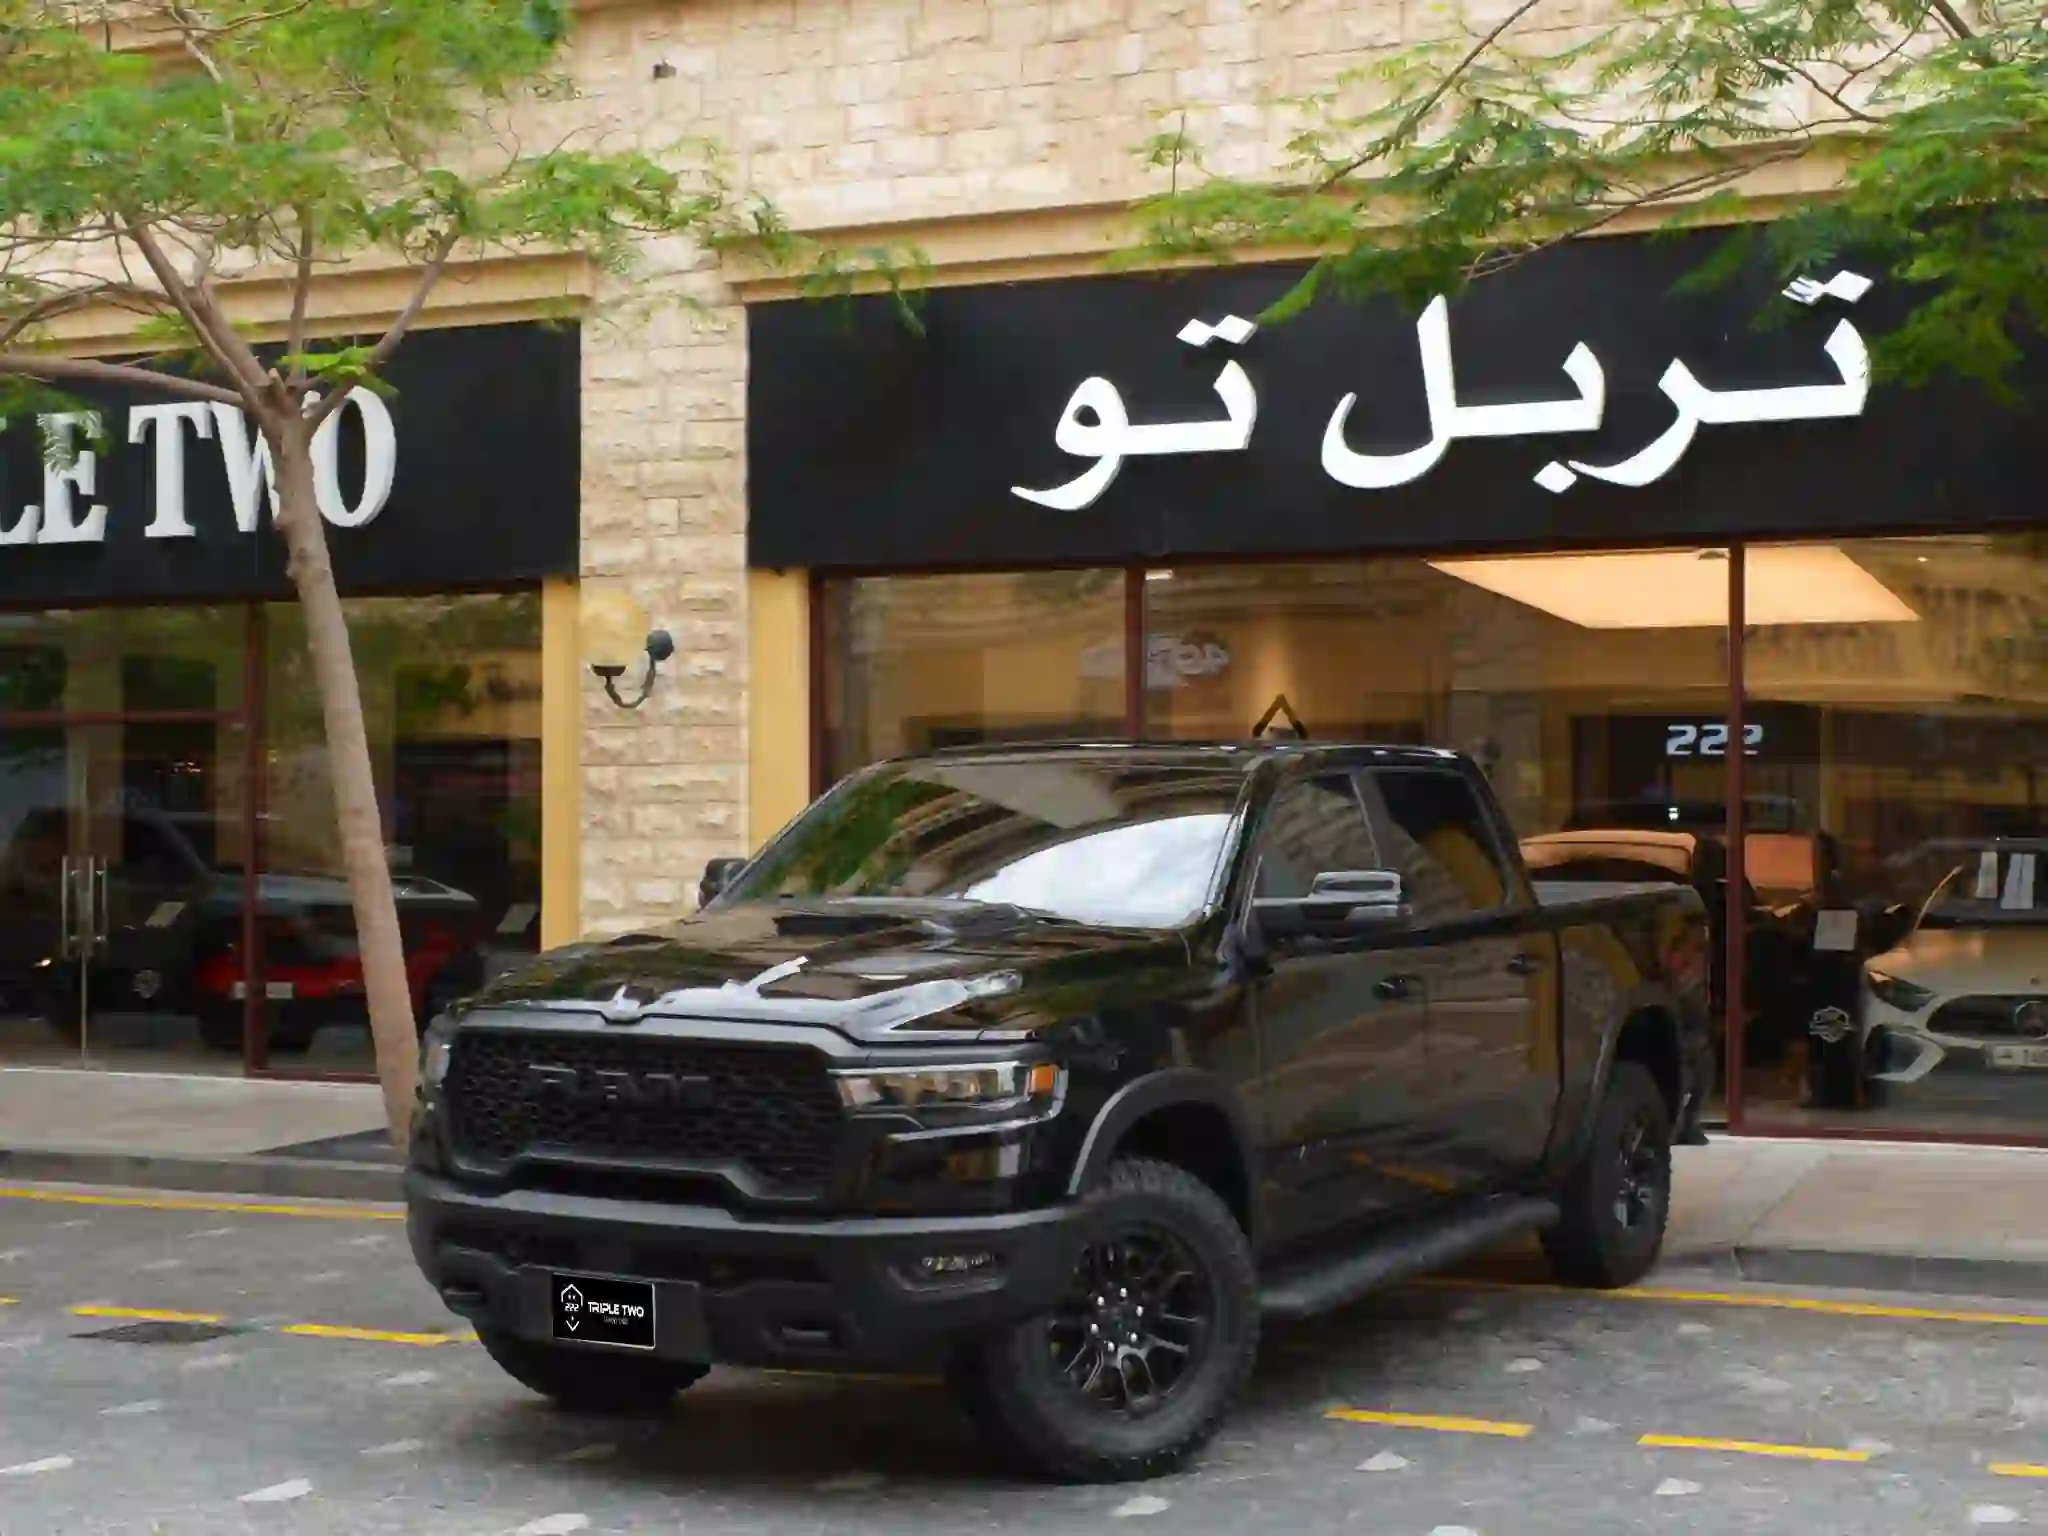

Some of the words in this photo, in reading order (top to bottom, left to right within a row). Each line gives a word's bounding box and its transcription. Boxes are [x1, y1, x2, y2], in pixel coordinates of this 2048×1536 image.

[1010, 314, 1257, 511] تو
[128, 386, 397, 538] TWO
[1666, 724, 1763, 755] 222
[564, 1302, 580, 1312] 222
[587, 1301, 620, 1315] TRIPLE
[621, 1304, 645, 1318] TWO
